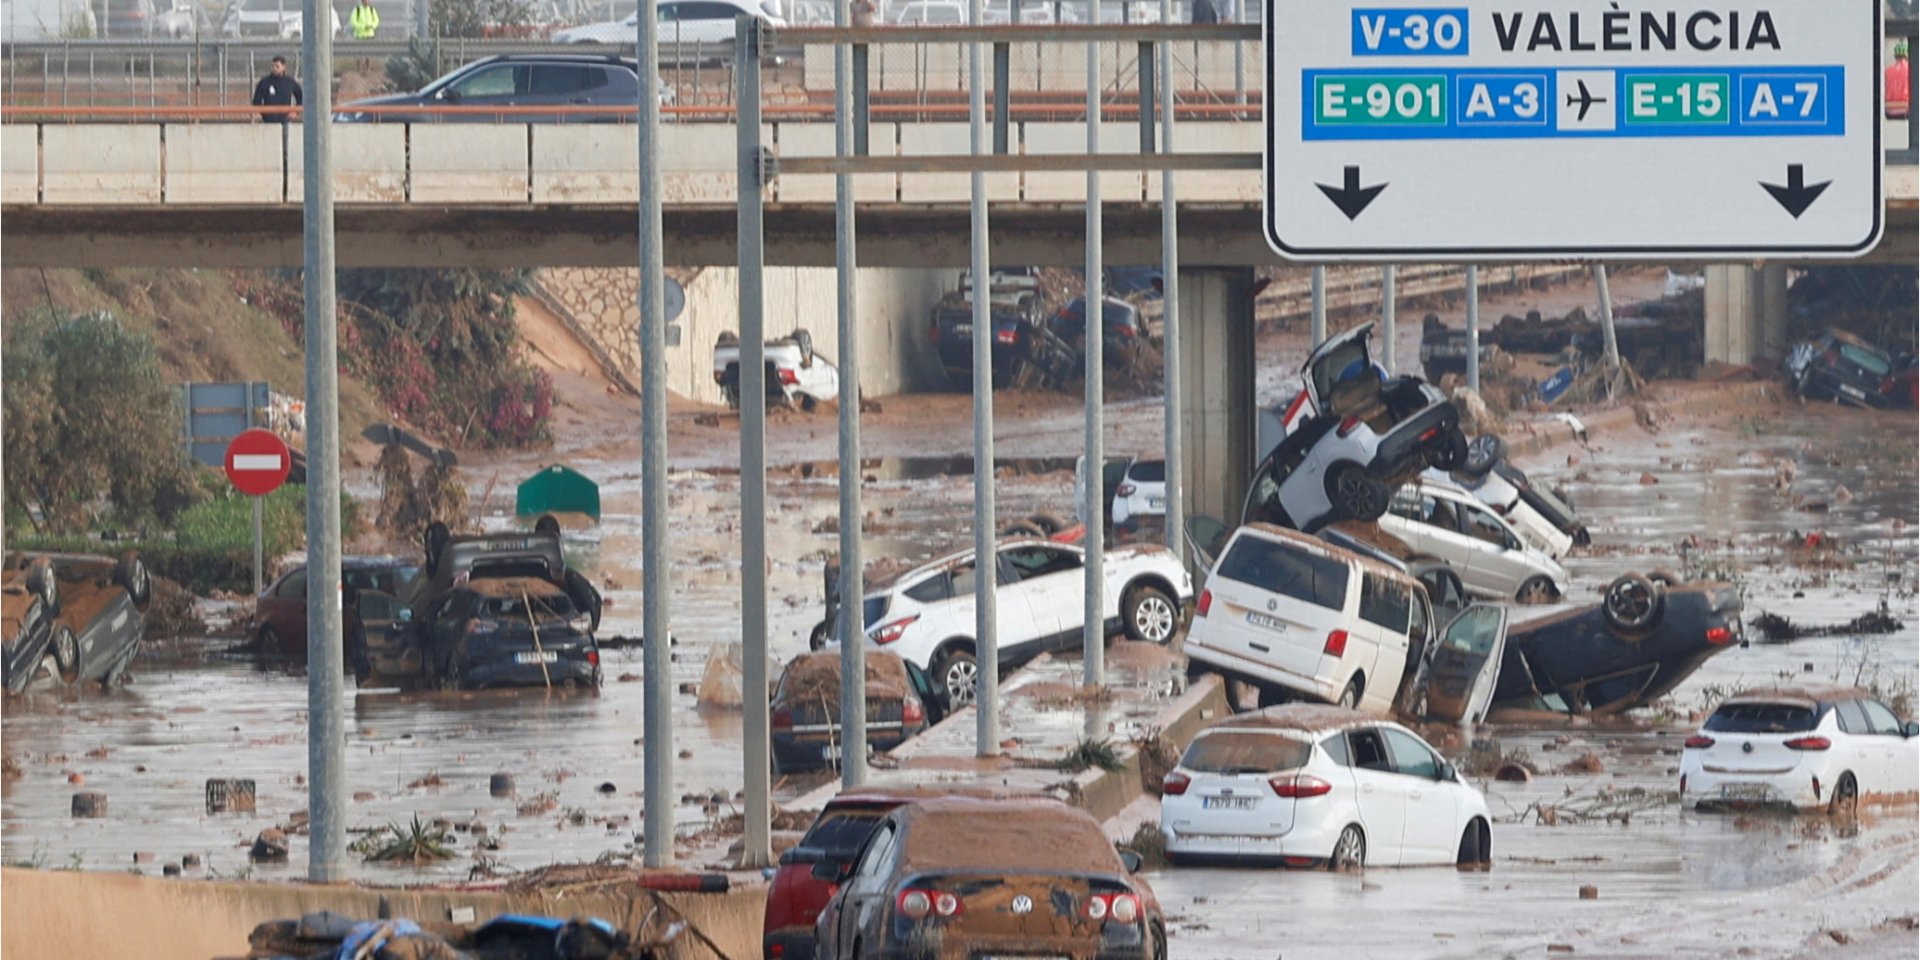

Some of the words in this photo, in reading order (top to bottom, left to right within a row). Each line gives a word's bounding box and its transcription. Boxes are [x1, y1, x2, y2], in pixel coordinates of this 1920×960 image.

[1360, 14, 1462, 50] V-30
[1491, 1, 1781, 52] VALÈNCIA
[1322, 83, 1440, 118] E-901
[1465, 82, 1539, 118] A-3
[1632, 82, 1722, 117] E-15
[1749, 82, 1819, 118] A-7
